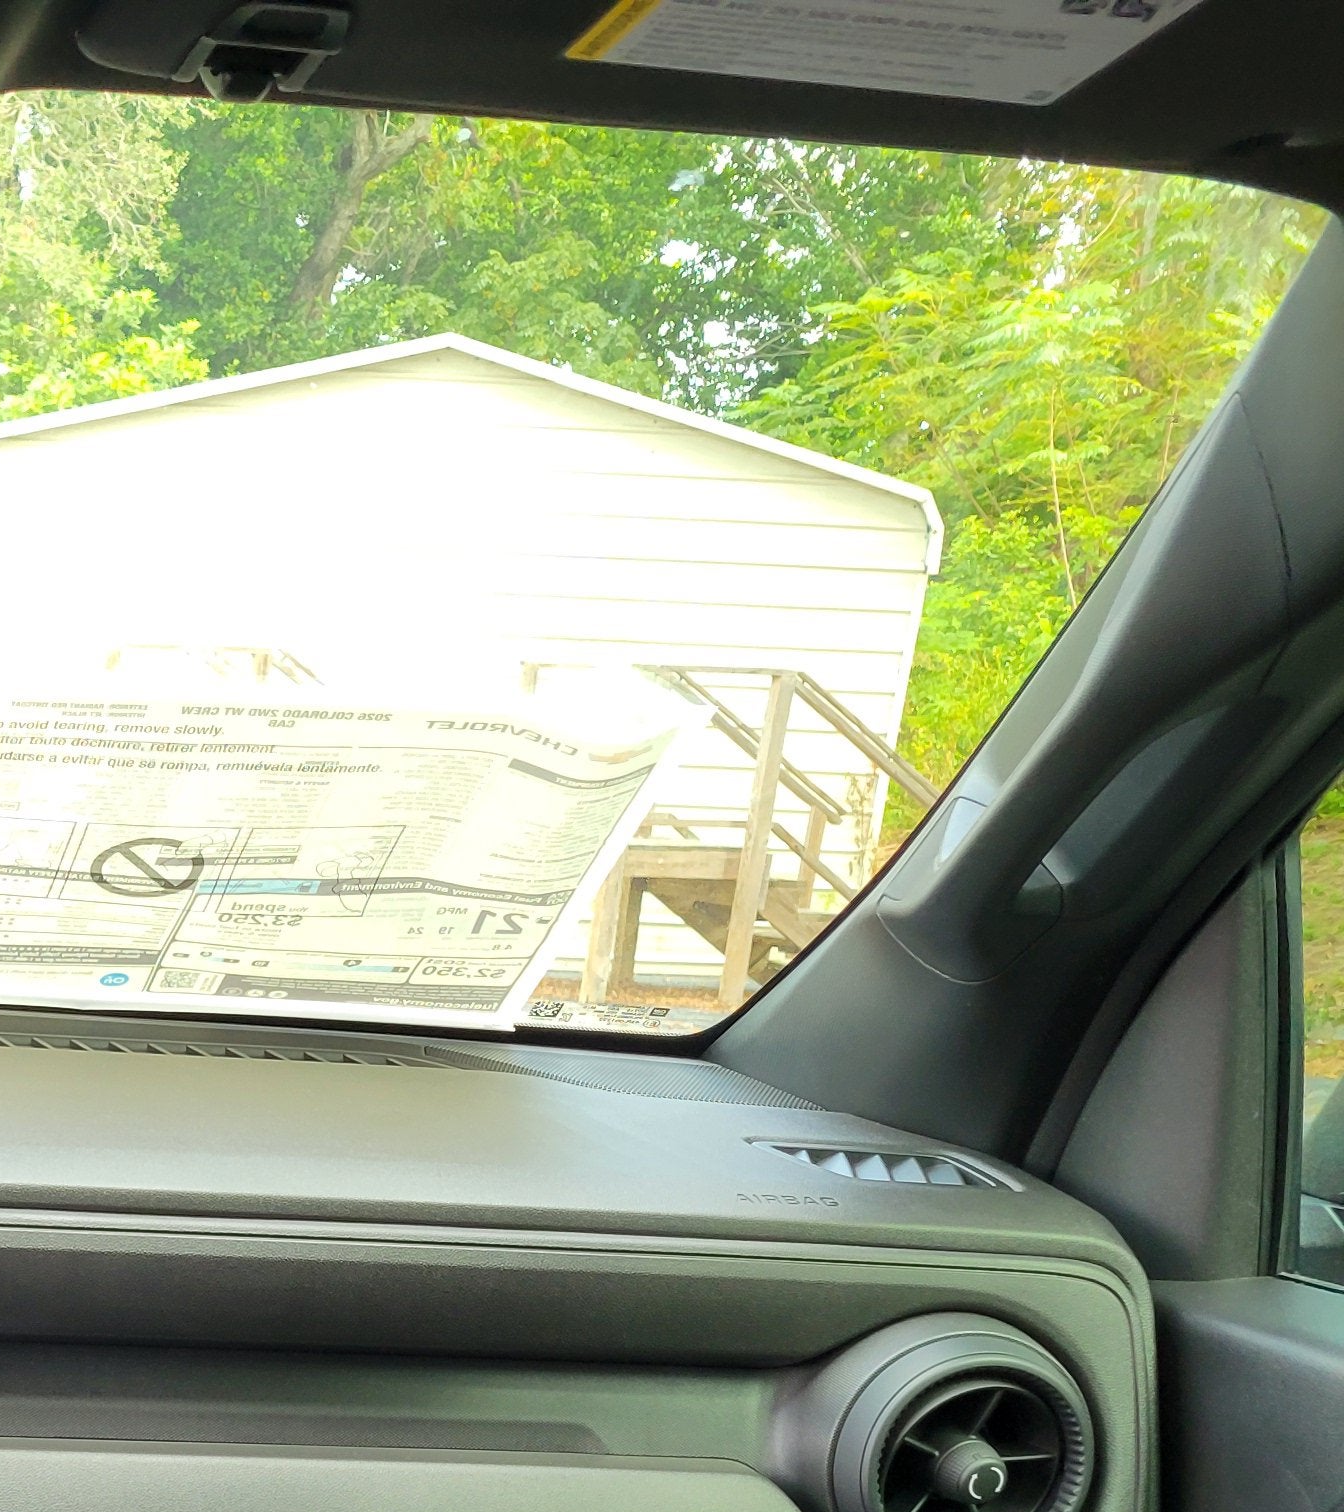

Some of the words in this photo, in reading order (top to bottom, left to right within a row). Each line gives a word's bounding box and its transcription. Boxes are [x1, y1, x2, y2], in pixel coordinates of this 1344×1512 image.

[9, 719, 48, 730] avoid
[54, 721, 108, 733] tearing,
[114, 723, 170, 735] remove
[49, 754, 57, 763] a
[62, 754, 103, 765] evitar
[107, 757, 135, 768] que
[138, 759, 156, 769] se
[736, 1193, 840, 1207] AIRBAG
